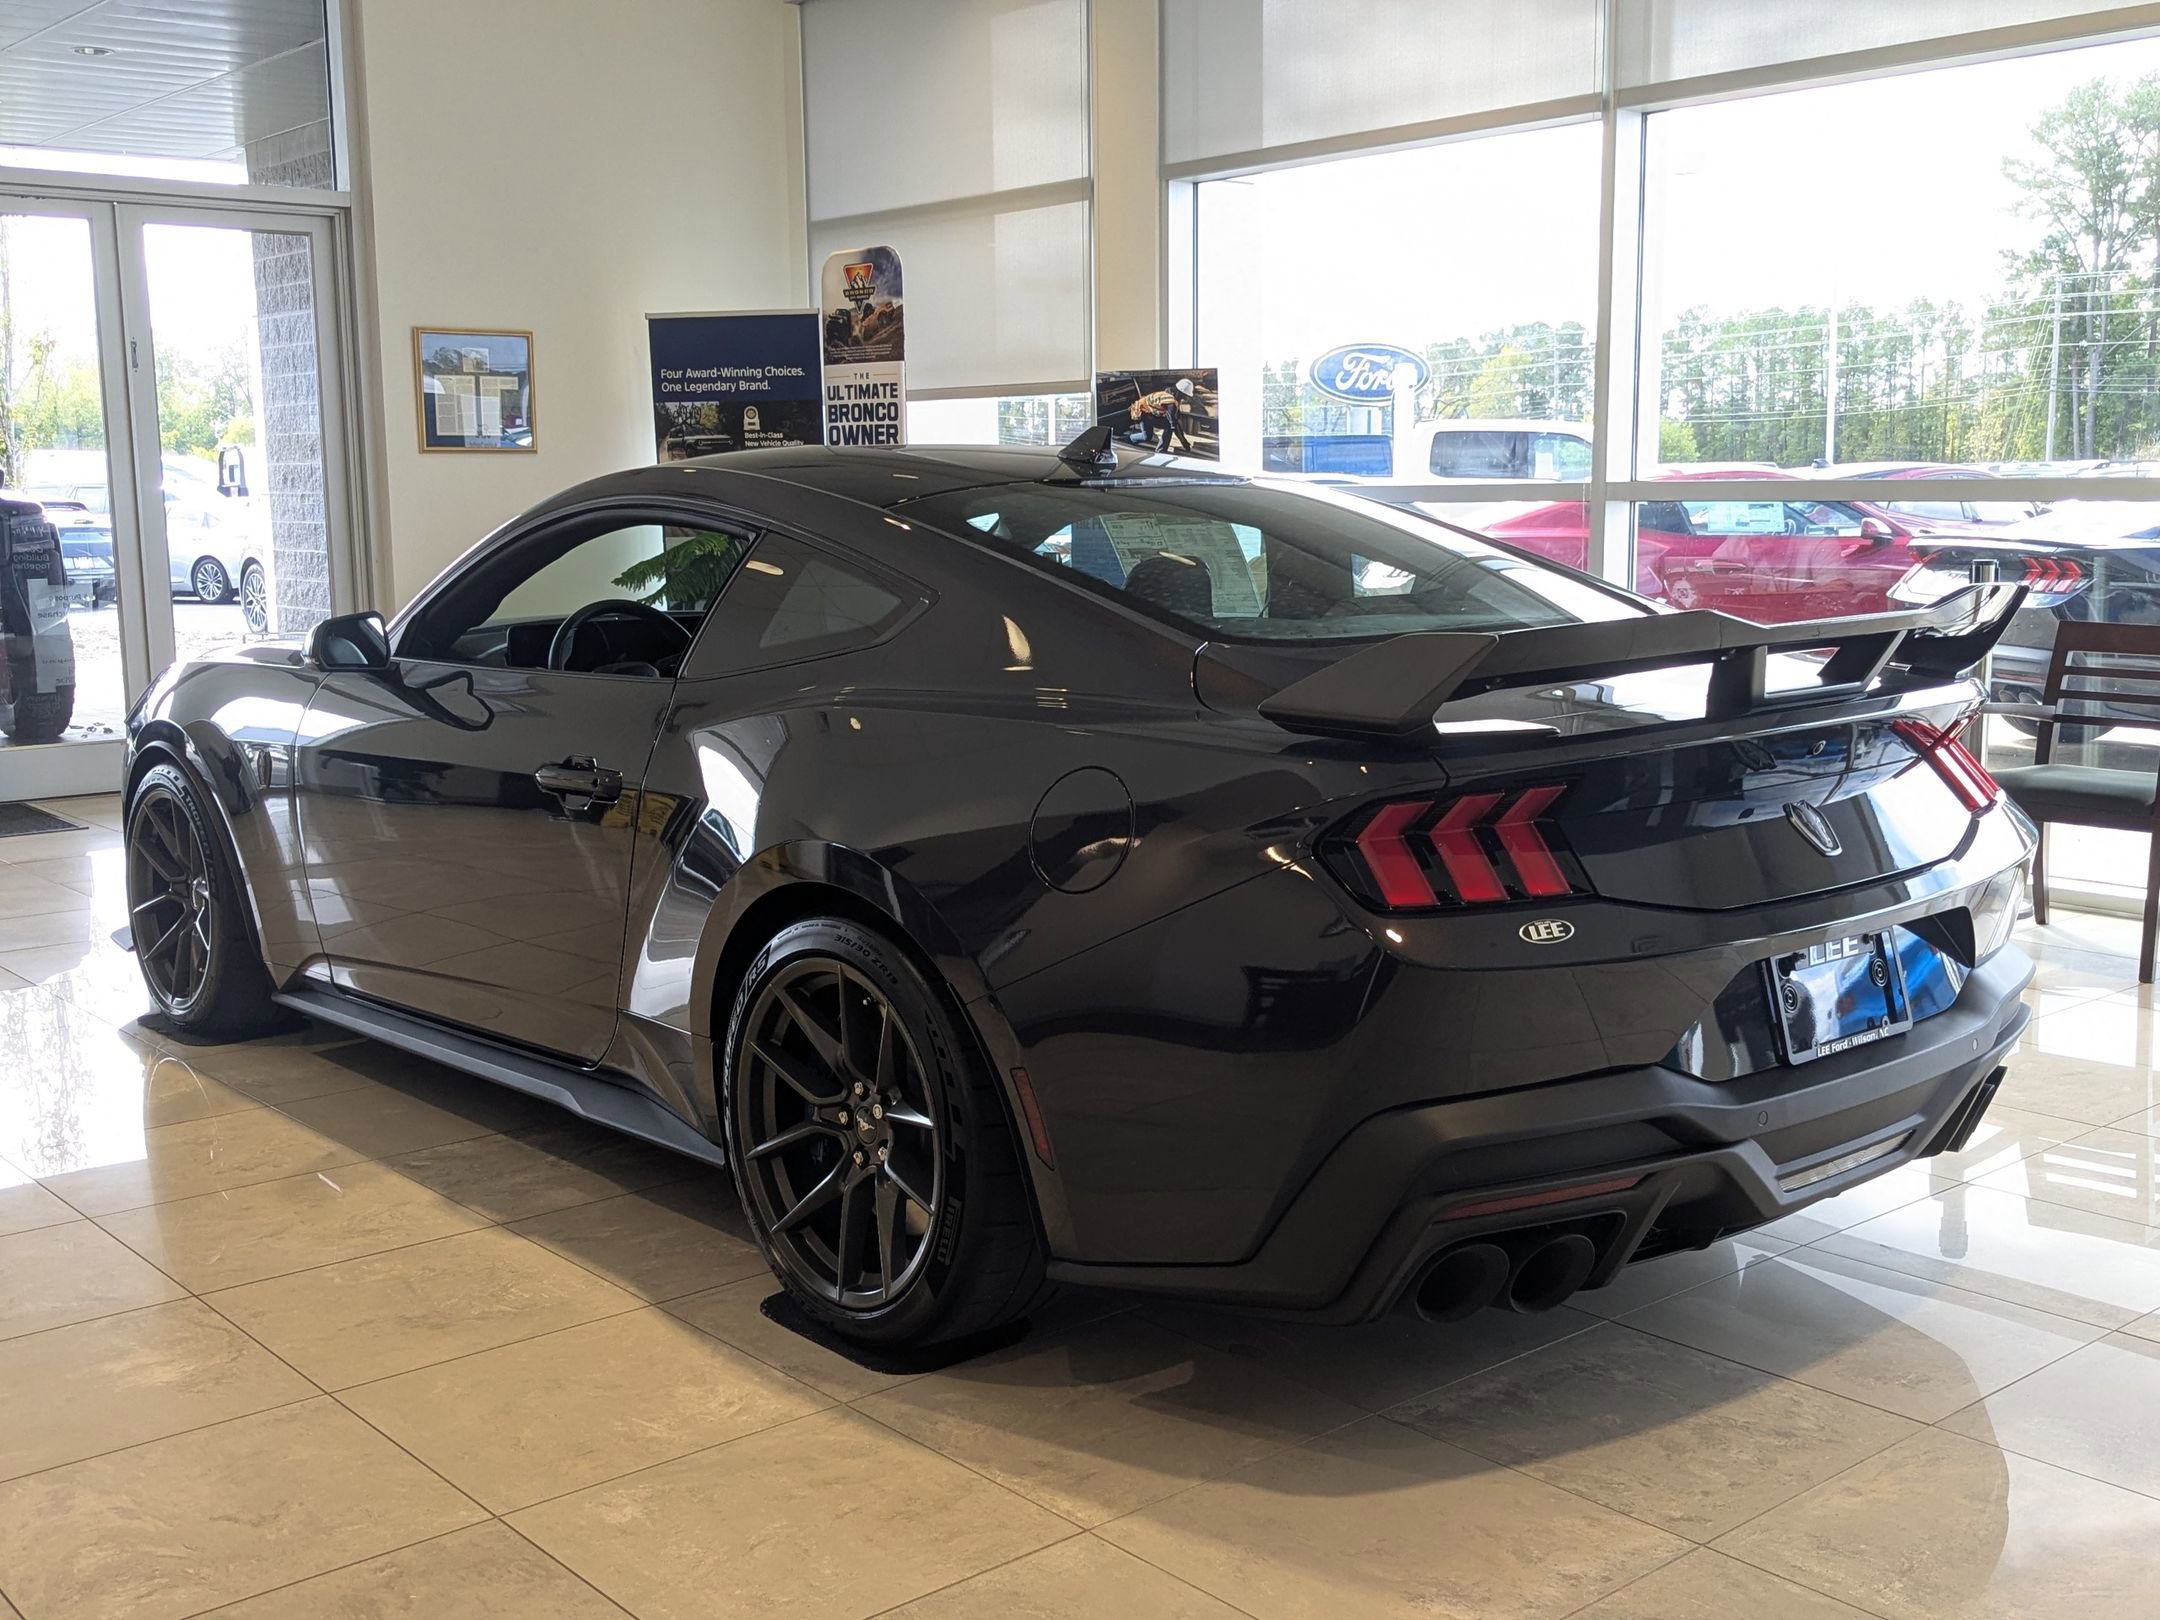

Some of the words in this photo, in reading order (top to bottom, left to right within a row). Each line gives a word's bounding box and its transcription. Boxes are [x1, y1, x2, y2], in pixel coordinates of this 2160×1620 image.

[660, 368, 683, 379] Four
[685, 366, 762, 379] Award-Winning
[764, 365, 806, 377] Choices.
[853, 372, 870, 380] THE
[661, 382, 682, 392] One
[684, 380, 736, 394] Legendary
[739, 379, 771, 391] Brand.
[827, 382, 899, 401] ULTIMATE
[827, 402, 899, 423] BRONCO
[828, 424, 899, 446] OWNER
[1528, 921, 1566, 940] LEE
[833, 933, 871, 958] 315/30
[871, 956, 899, 985] ZR19
[1809, 937, 1859, 966] LEE
[1817, 1045, 1831, 1057] LEE
[1831, 1039, 1848, 1053] Ford
